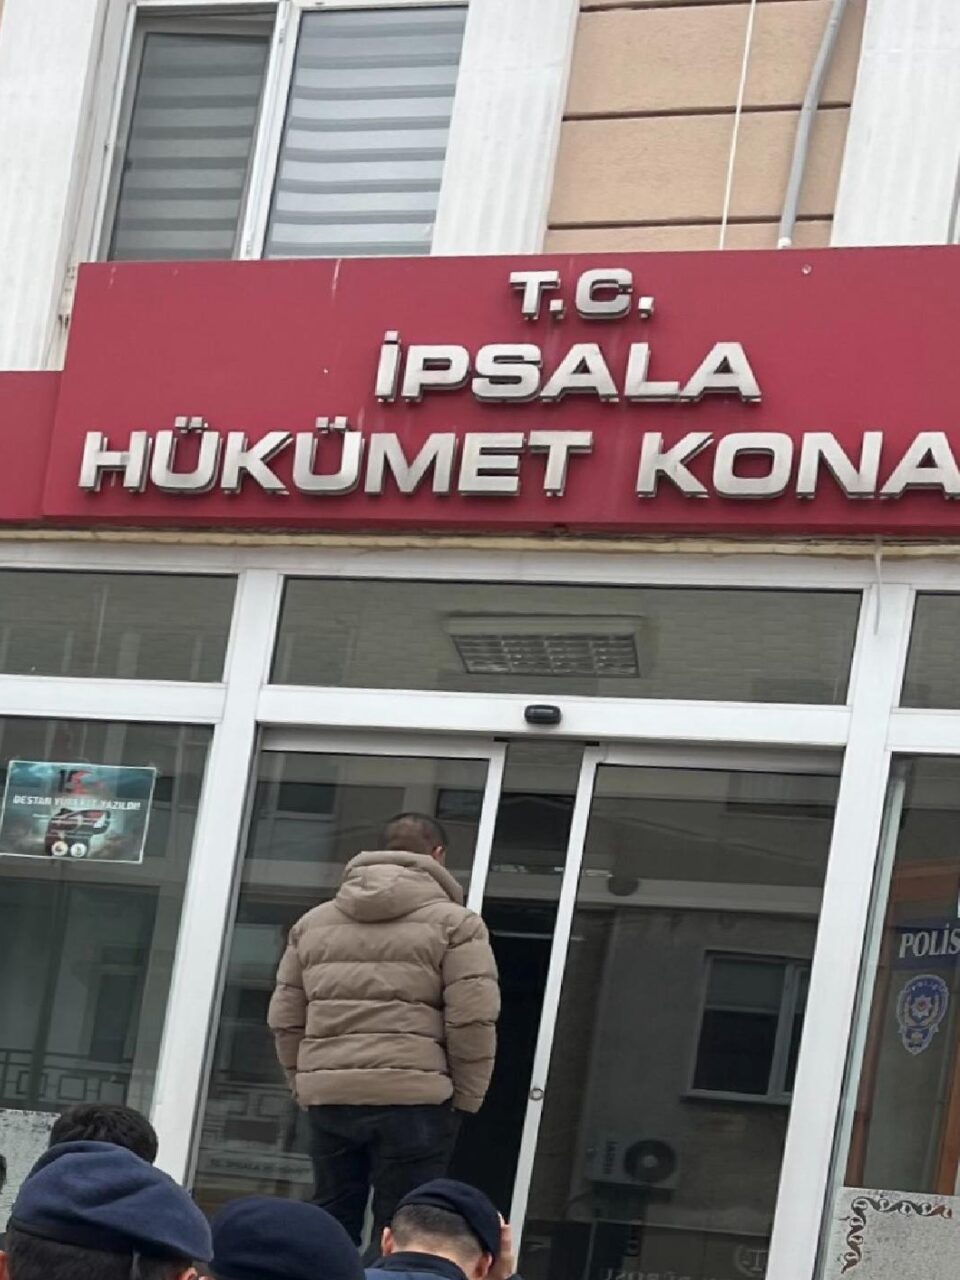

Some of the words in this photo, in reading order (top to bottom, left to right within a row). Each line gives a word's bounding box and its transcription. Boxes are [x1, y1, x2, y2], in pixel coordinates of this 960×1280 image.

[510, 267, 655, 320] T.C.
[375, 330, 761, 402] İPSALA
[78, 416, 593, 497] HÜKÜMET
[636, 432, 960, 499] KONA
[899, 924, 960, 959] POLİS
